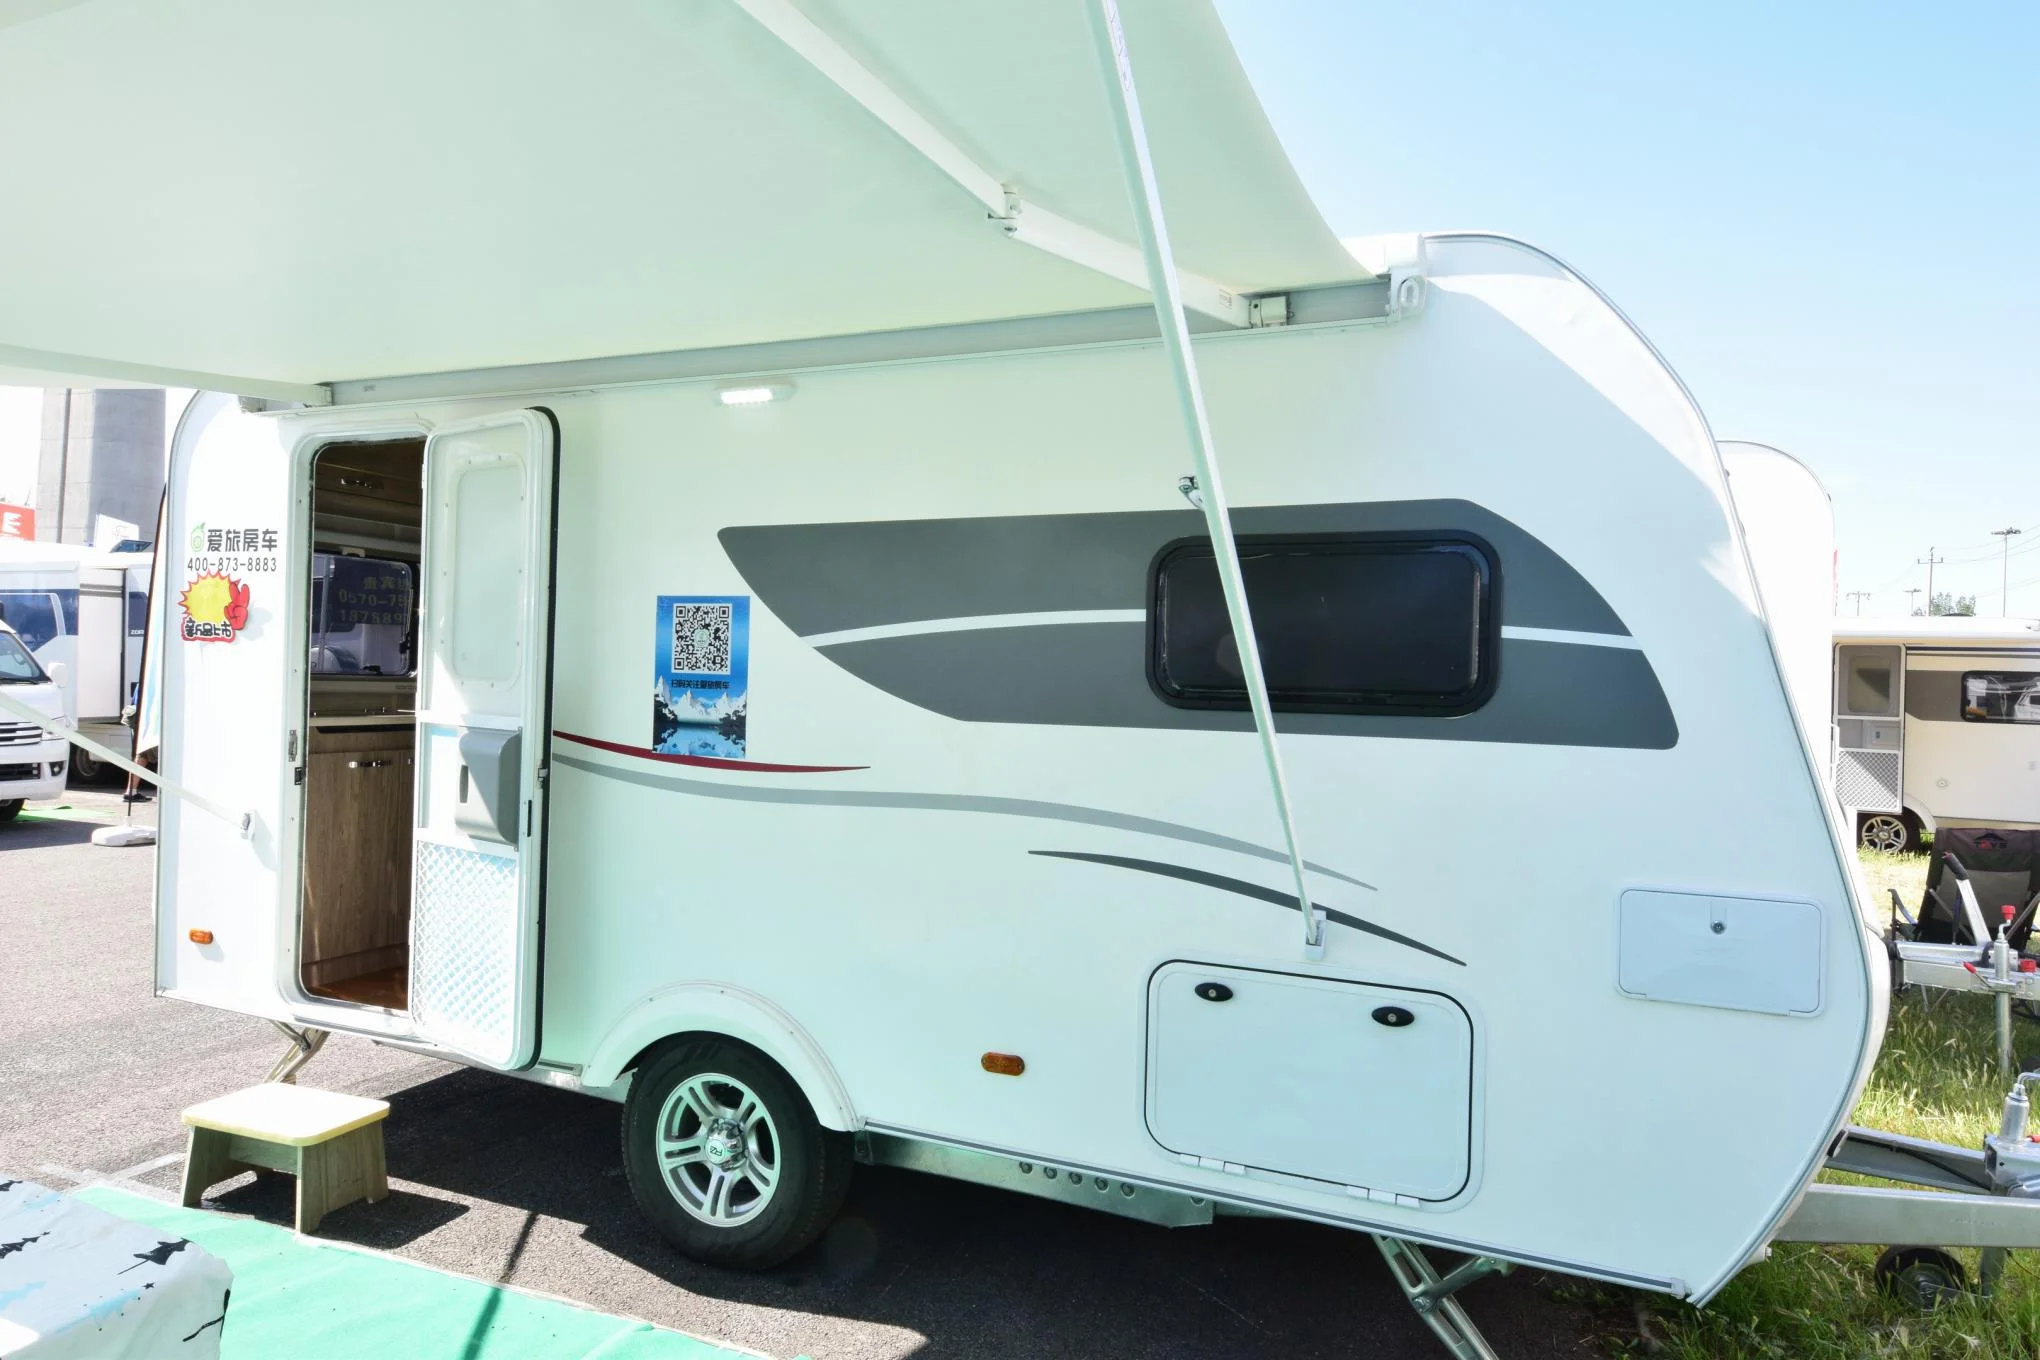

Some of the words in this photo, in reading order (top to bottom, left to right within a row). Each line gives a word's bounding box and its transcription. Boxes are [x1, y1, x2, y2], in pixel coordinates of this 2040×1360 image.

[207, 528, 278, 552] 爱旅房车
[187, 557, 277, 572] 400-873-8883
